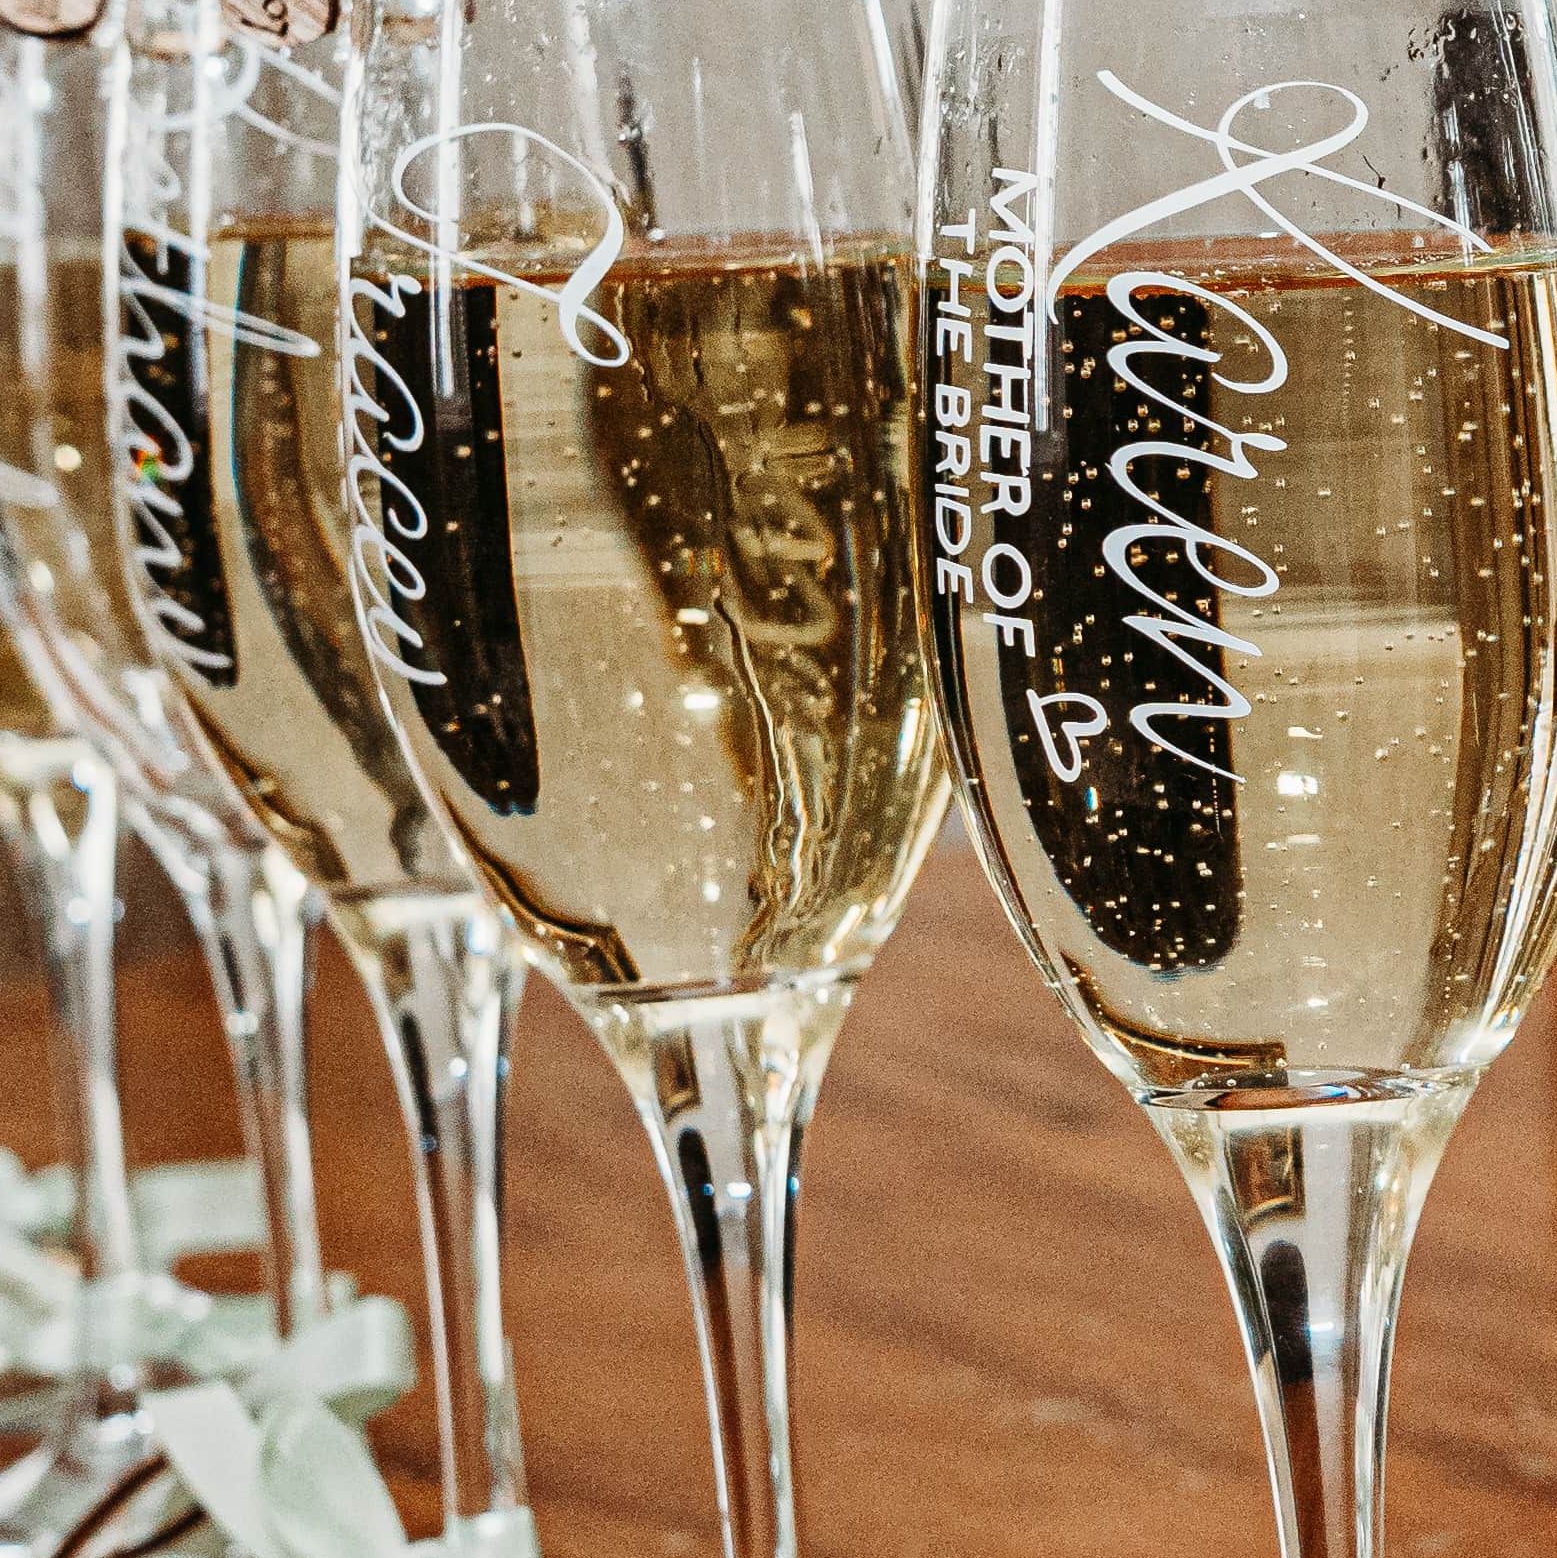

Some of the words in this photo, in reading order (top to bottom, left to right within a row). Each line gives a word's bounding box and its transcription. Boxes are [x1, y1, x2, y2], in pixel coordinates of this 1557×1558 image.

[934, 208, 977, 354] THE
[978, 166, 1041, 516] MOTHER
[934, 383, 975, 605] BRIDE
[1046, 70, 1510, 783] Karen
[981, 542, 1037, 658] OF
